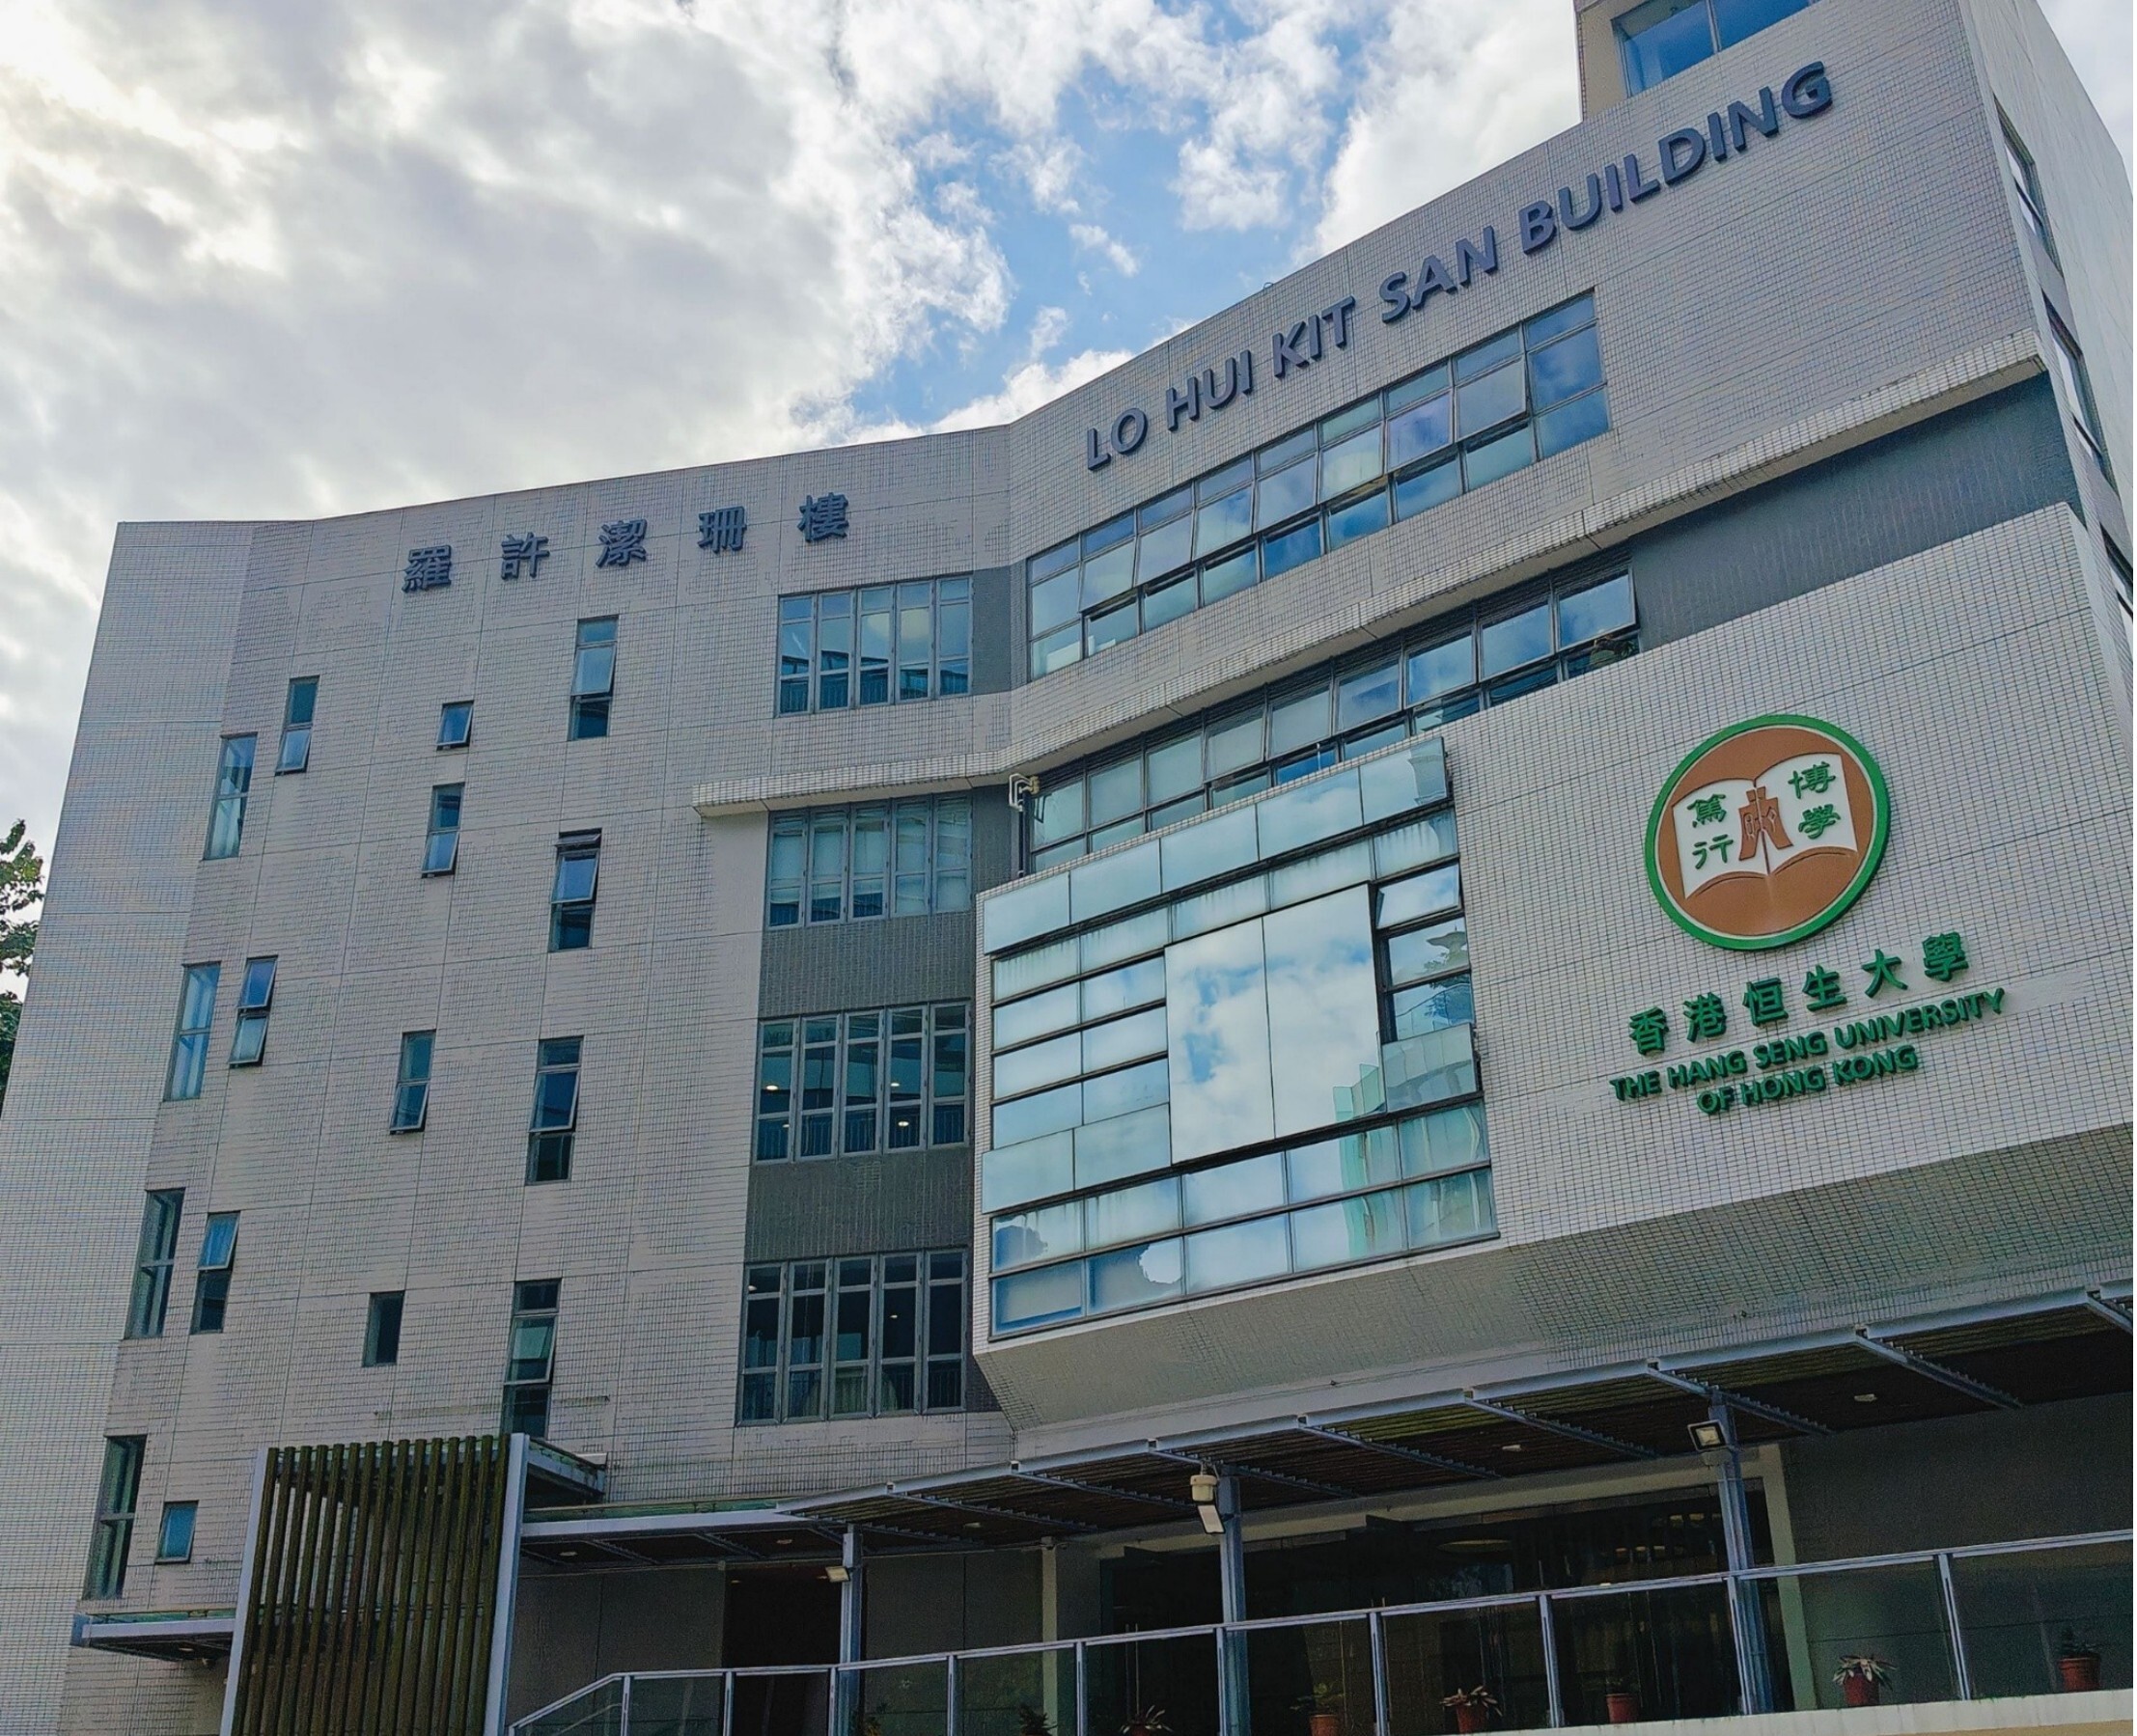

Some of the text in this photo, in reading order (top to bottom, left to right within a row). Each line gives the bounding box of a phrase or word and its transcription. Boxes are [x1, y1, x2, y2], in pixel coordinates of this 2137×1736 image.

[1085, 60, 1834, 472] LO HUI KIT SAN BUILDING
[401, 491, 850, 593] 羅許潔珊樓
[1610, 987, 2006, 1102] THE HANG SENG UNIVERSITY
[1628, 931, 1970, 1057] 香港恒生大學
[1696, 1044, 1920, 1116] OF HONG KONG
